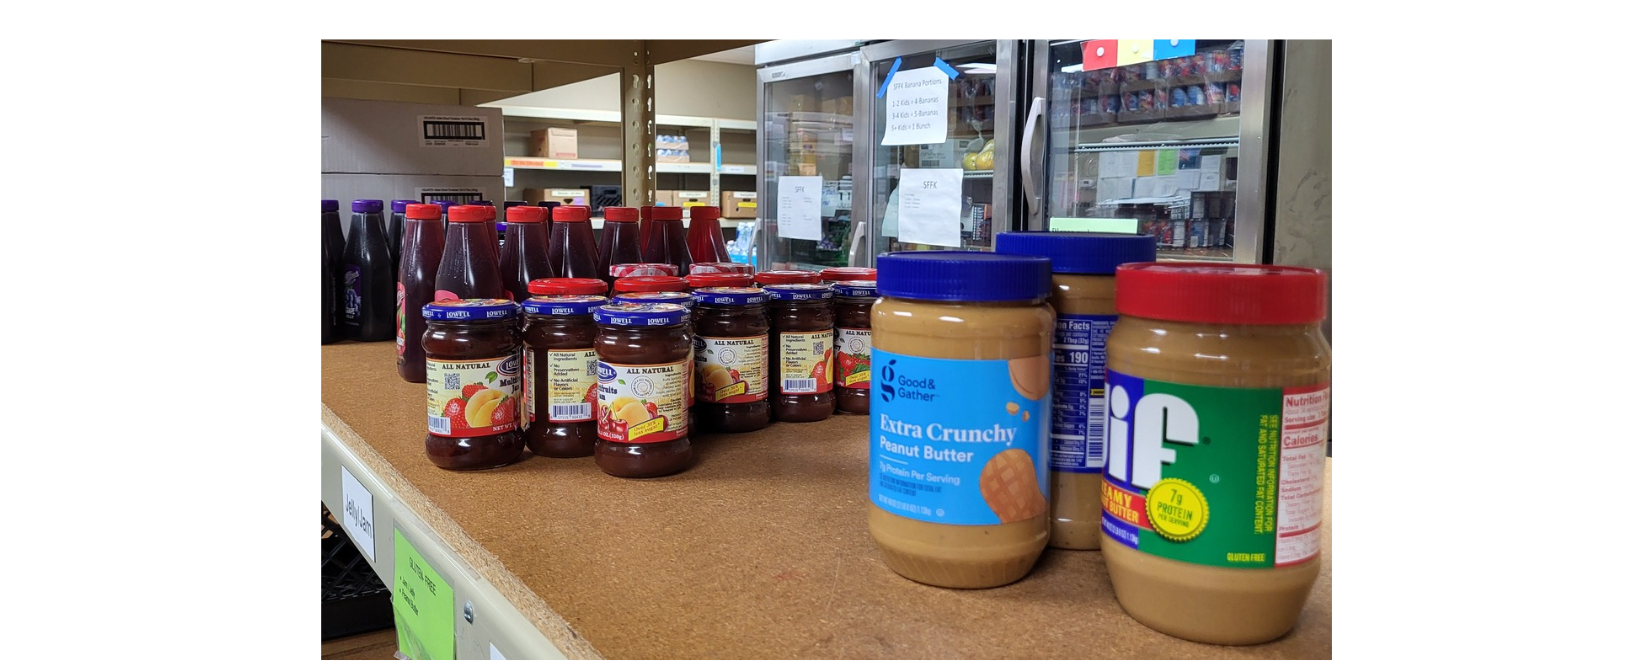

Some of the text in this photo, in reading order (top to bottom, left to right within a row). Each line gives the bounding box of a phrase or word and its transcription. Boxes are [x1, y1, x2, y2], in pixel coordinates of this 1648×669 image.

[905, 81, 921, 89] Banana
[922, 79, 942, 87] Portions
[900, 110, 910, 118] Kids
[898, 123, 908, 131] Kids
[916, 122, 931, 130] Bunch
[923, 181, 938, 189] SFFK
[446, 310, 471, 319] LOWELL
[486, 310, 508, 318] LOWELL
[551, 307, 574, 315] LOWELL
[611, 317, 632, 325] LOWELL
[648, 317, 670, 325] LOWELL
[1069, 321, 1090, 330] Facts
[1068, 337, 1077, 345] Tbsp
[1070, 351, 1089, 364] 190
[898, 375, 935, 389] Good &
[1286, 393, 1321, 407] Nutrition
[1260, 415, 1268, 427] FAT
[1285, 416, 1305, 424] Serving
[880, 413, 1017, 446] Extra Crunchy
[1258, 429, 1267, 443] AND
[1284, 433, 1318, 447] Calories
[880, 435, 974, 462] Peanut Butter
[1256, 445, 1266, 486] SATURATED
[886, 463, 910, 478] Protein
[911, 470, 925, 480] Per
[926, 472, 961, 486] Serving
[1264, 415, 1278, 532] SEE NUTRITION INFORMATION FOR
[1171, 489, 1182, 505] 7g
[1256, 487, 1264, 498] FAT
[1110, 501, 1139, 523] BUTTER
[1157, 501, 1193, 520] PROTEIN
[1168, 516, 1189, 528] SERVING
[1227, 552, 1265, 561] GLUTEN FREE
[425, 575, 436, 597] FREE
